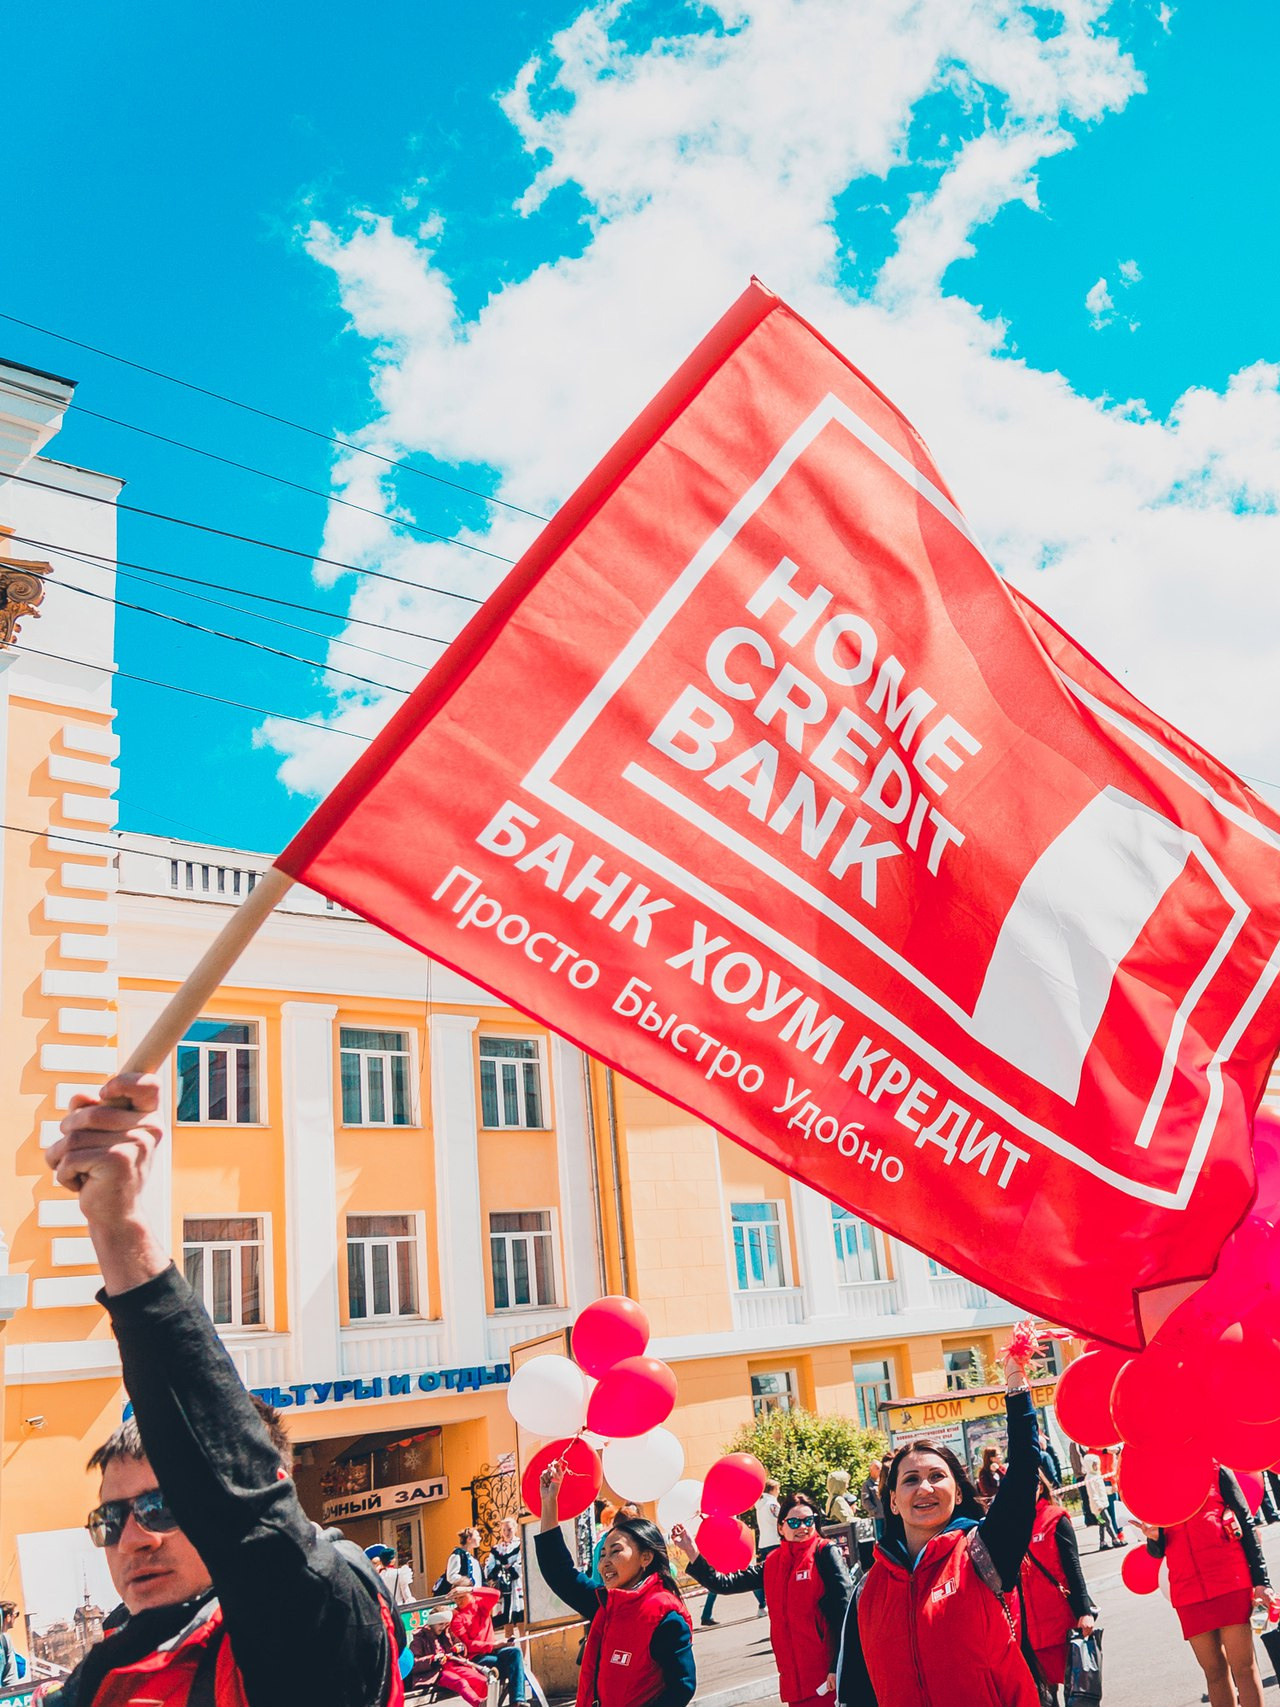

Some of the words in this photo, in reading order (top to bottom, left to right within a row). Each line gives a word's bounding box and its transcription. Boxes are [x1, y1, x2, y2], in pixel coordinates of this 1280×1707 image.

[706, 626, 966, 878] CREDIT
[745, 556, 983, 796] HOME
[647, 683, 903, 909] BANK
[431, 865, 600, 990] Просто
[611, 976, 765, 1093] Быстро
[773, 1077, 904, 1183] Удобно
[476, 799, 676, 948] БАНК
[665, 920, 845, 1064] ХОУМ
[839, 1035, 1031, 1189] КРЕДИТ
[249, 1377, 383, 1408] ЛЬТУРЫ
[389, 1374, 411, 1396] И
[395, 1484, 443, 1503] ЗАЛ
[923, 1401, 962, 1424] ДОМ
